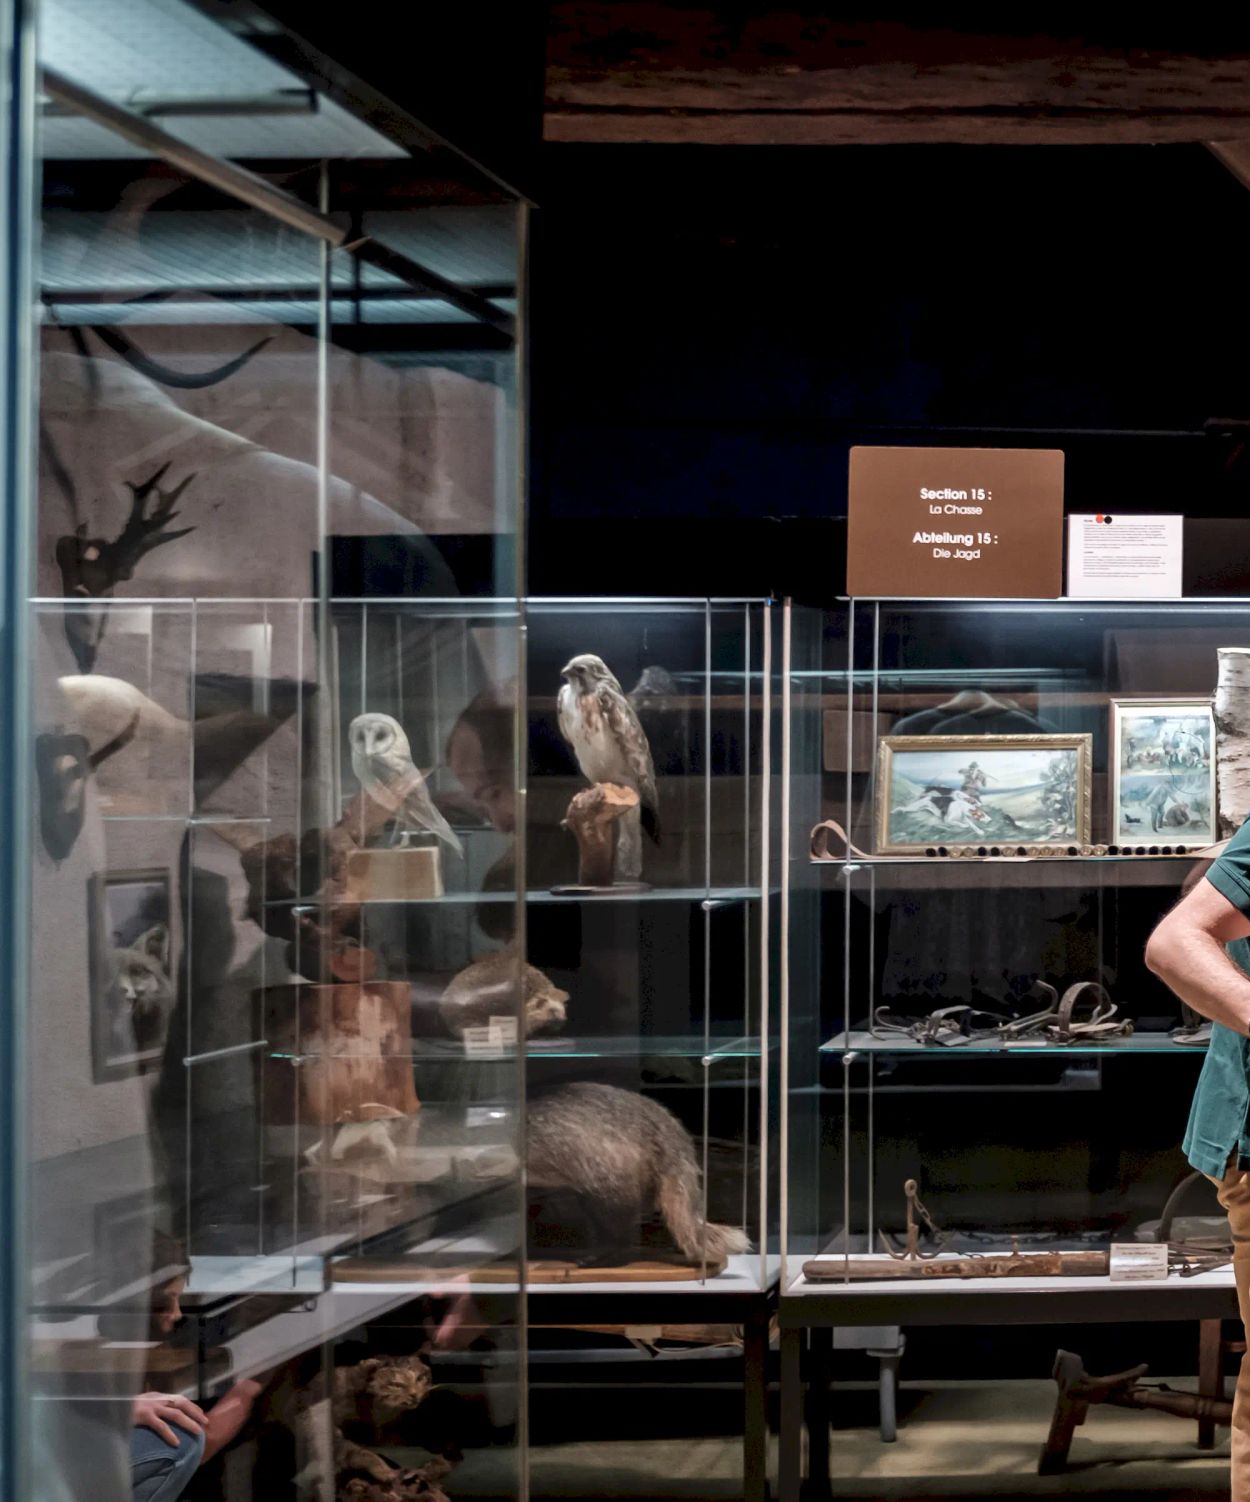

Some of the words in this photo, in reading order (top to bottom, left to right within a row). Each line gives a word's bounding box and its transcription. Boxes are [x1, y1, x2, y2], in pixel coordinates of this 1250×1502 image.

[920, 488, 967, 500] Section
[929, 504, 942, 515] La
[944, 504, 983, 515] Chasse
[912, 531, 974, 547] Abteilung
[933, 548, 951, 558] Die
[952, 548, 981, 561] Jagd
